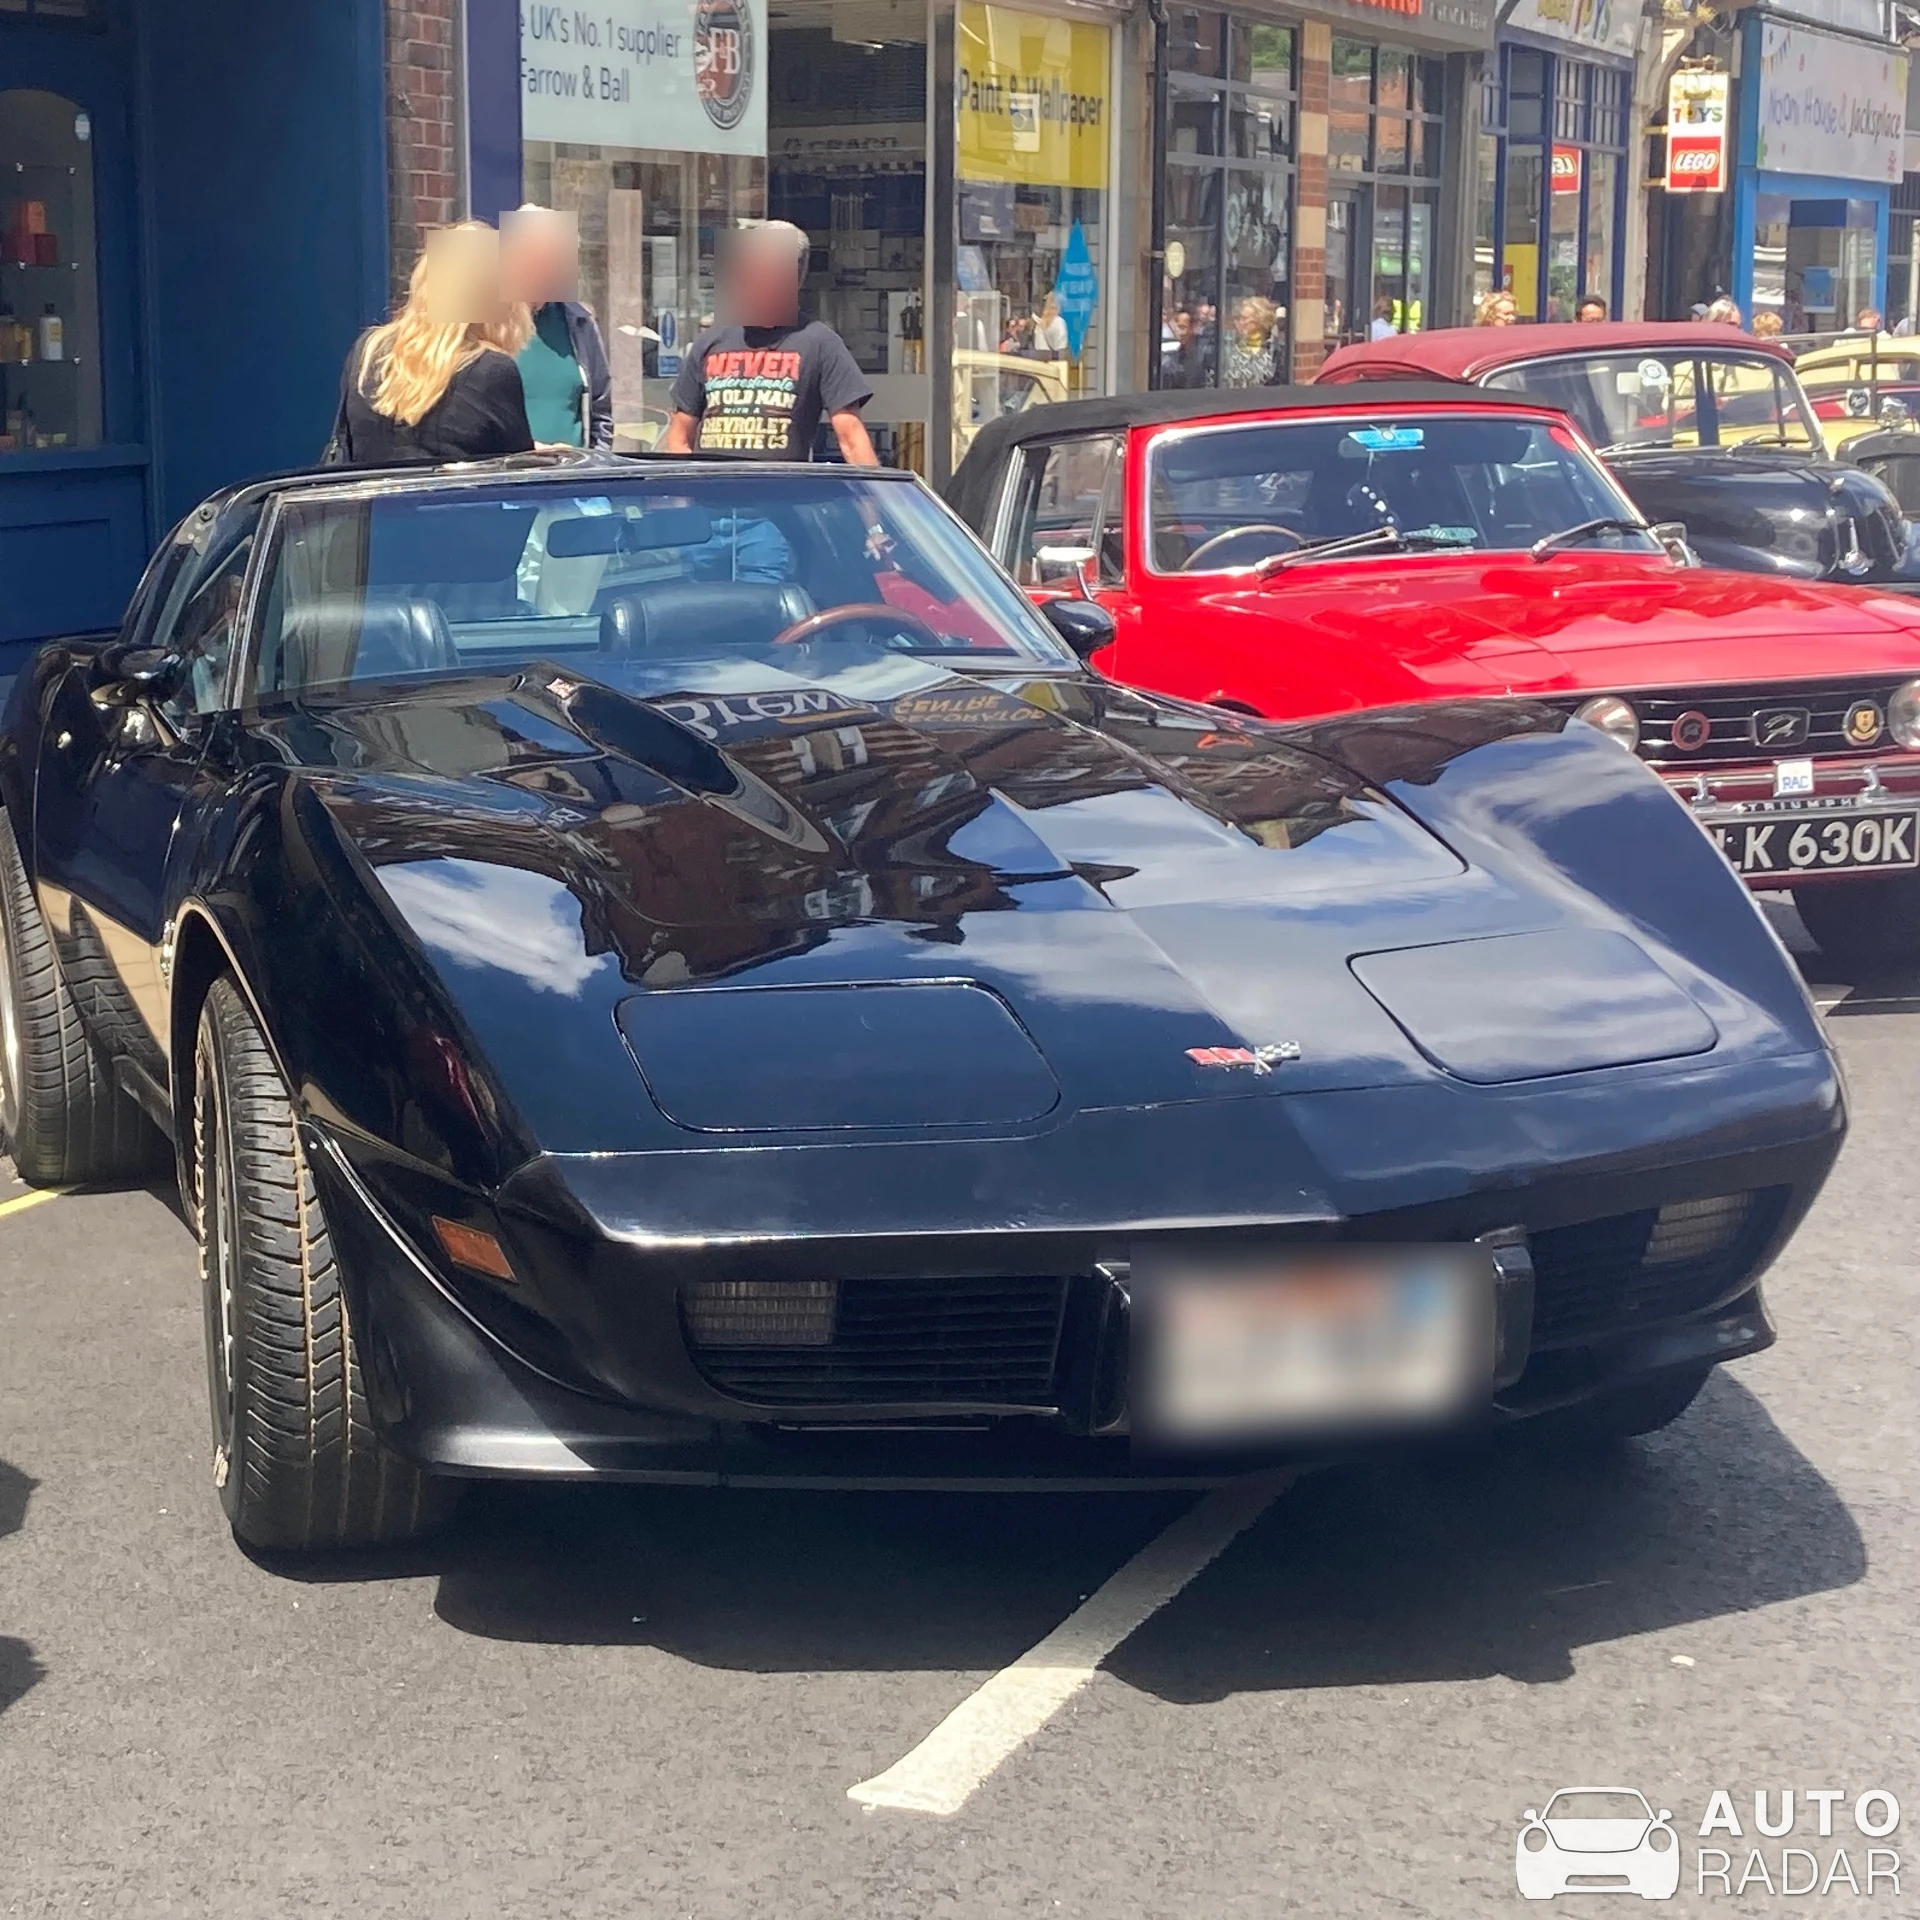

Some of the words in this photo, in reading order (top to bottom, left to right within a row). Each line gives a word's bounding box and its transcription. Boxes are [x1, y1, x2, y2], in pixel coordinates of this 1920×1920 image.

[530, 4, 569, 43] UK's
[574, 10, 601, 48] No.
[605, 17, 613, 49] 1
[617, 21, 681, 65] supplier
[582, 65, 595, 99] &
[600, 66, 630, 103] Ball
[960, 68, 1003, 116] Paint
[1674, 152, 1717, 171] LEGO
[706, 351, 801, 380] NEVER
[722, 389, 754, 405] OLD
[754, 389, 797, 409] MAN
[767, 434, 788, 449] C3
[1782, 775, 1809, 790] RAC
[1747, 797, 1857, 812] TRIUMPH
[1788, 817, 1913, 866] 630K
